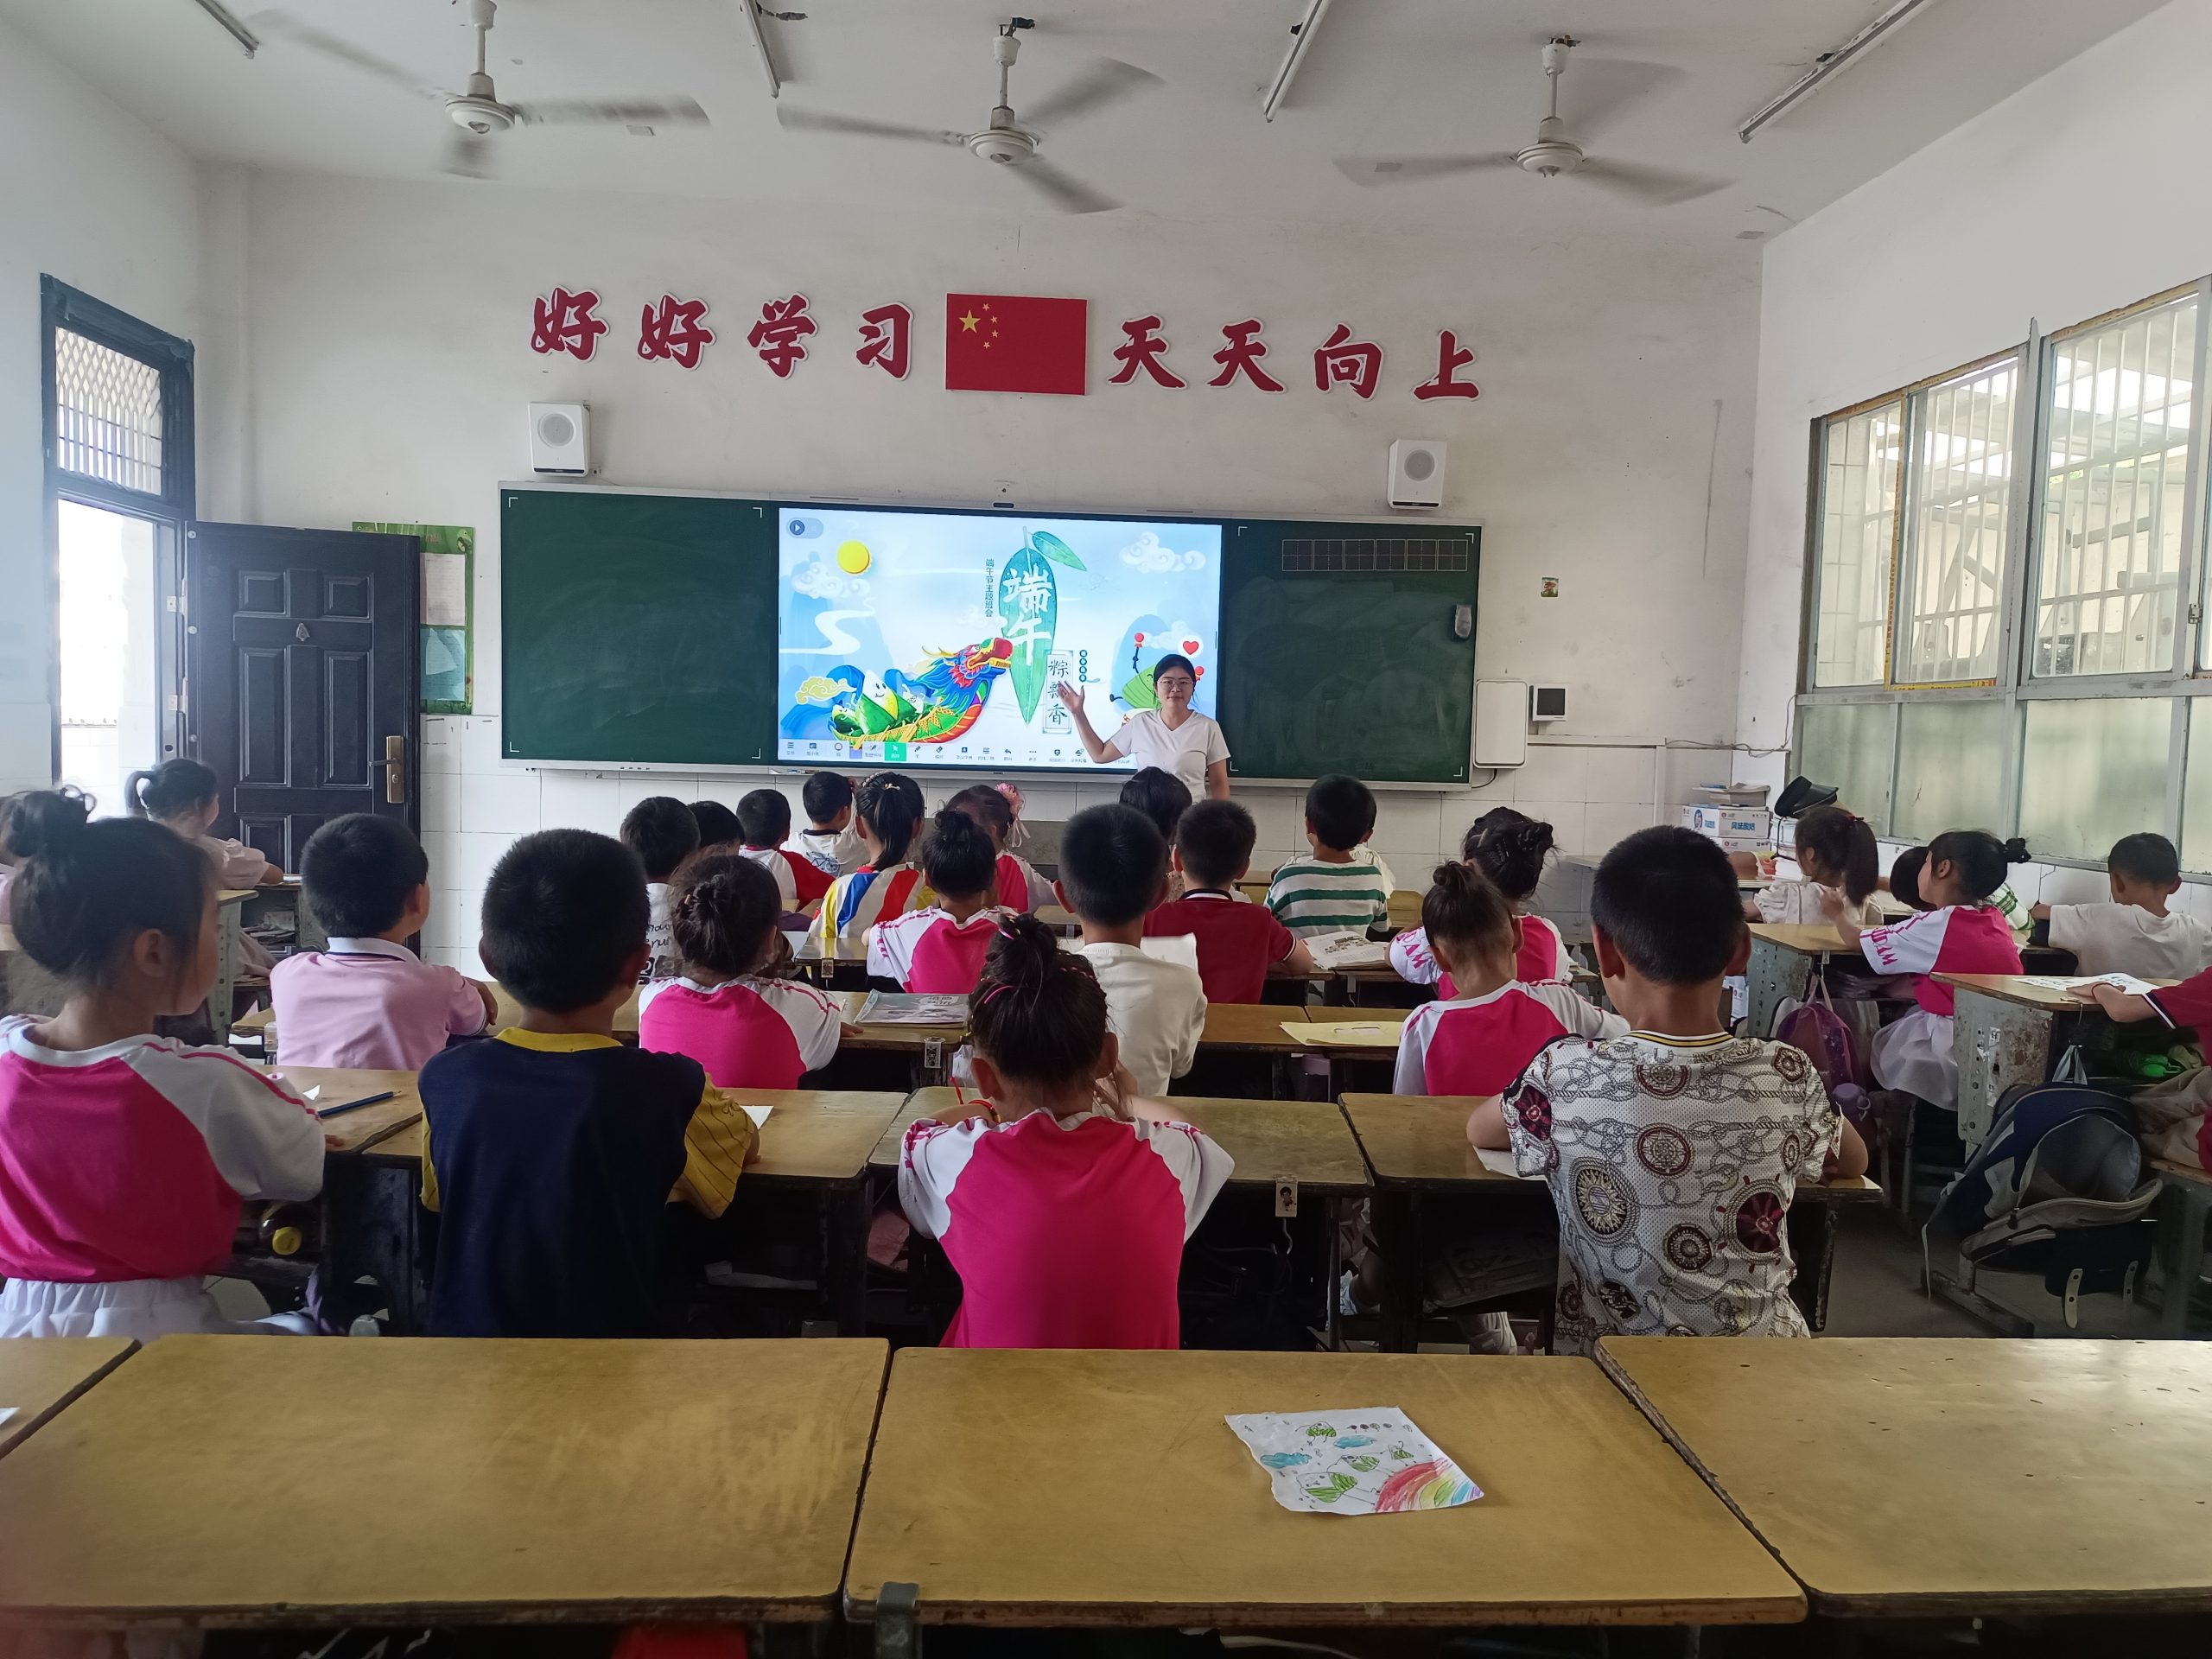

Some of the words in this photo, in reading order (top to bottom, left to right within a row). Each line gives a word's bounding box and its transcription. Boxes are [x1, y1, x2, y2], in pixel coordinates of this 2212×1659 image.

[530, 286, 912, 379] 好好学习
[1109, 314, 1479, 401] 天天向上
[985, 558, 995, 617] 端午节主题班会
[1002, 563, 1054, 666] 端午
